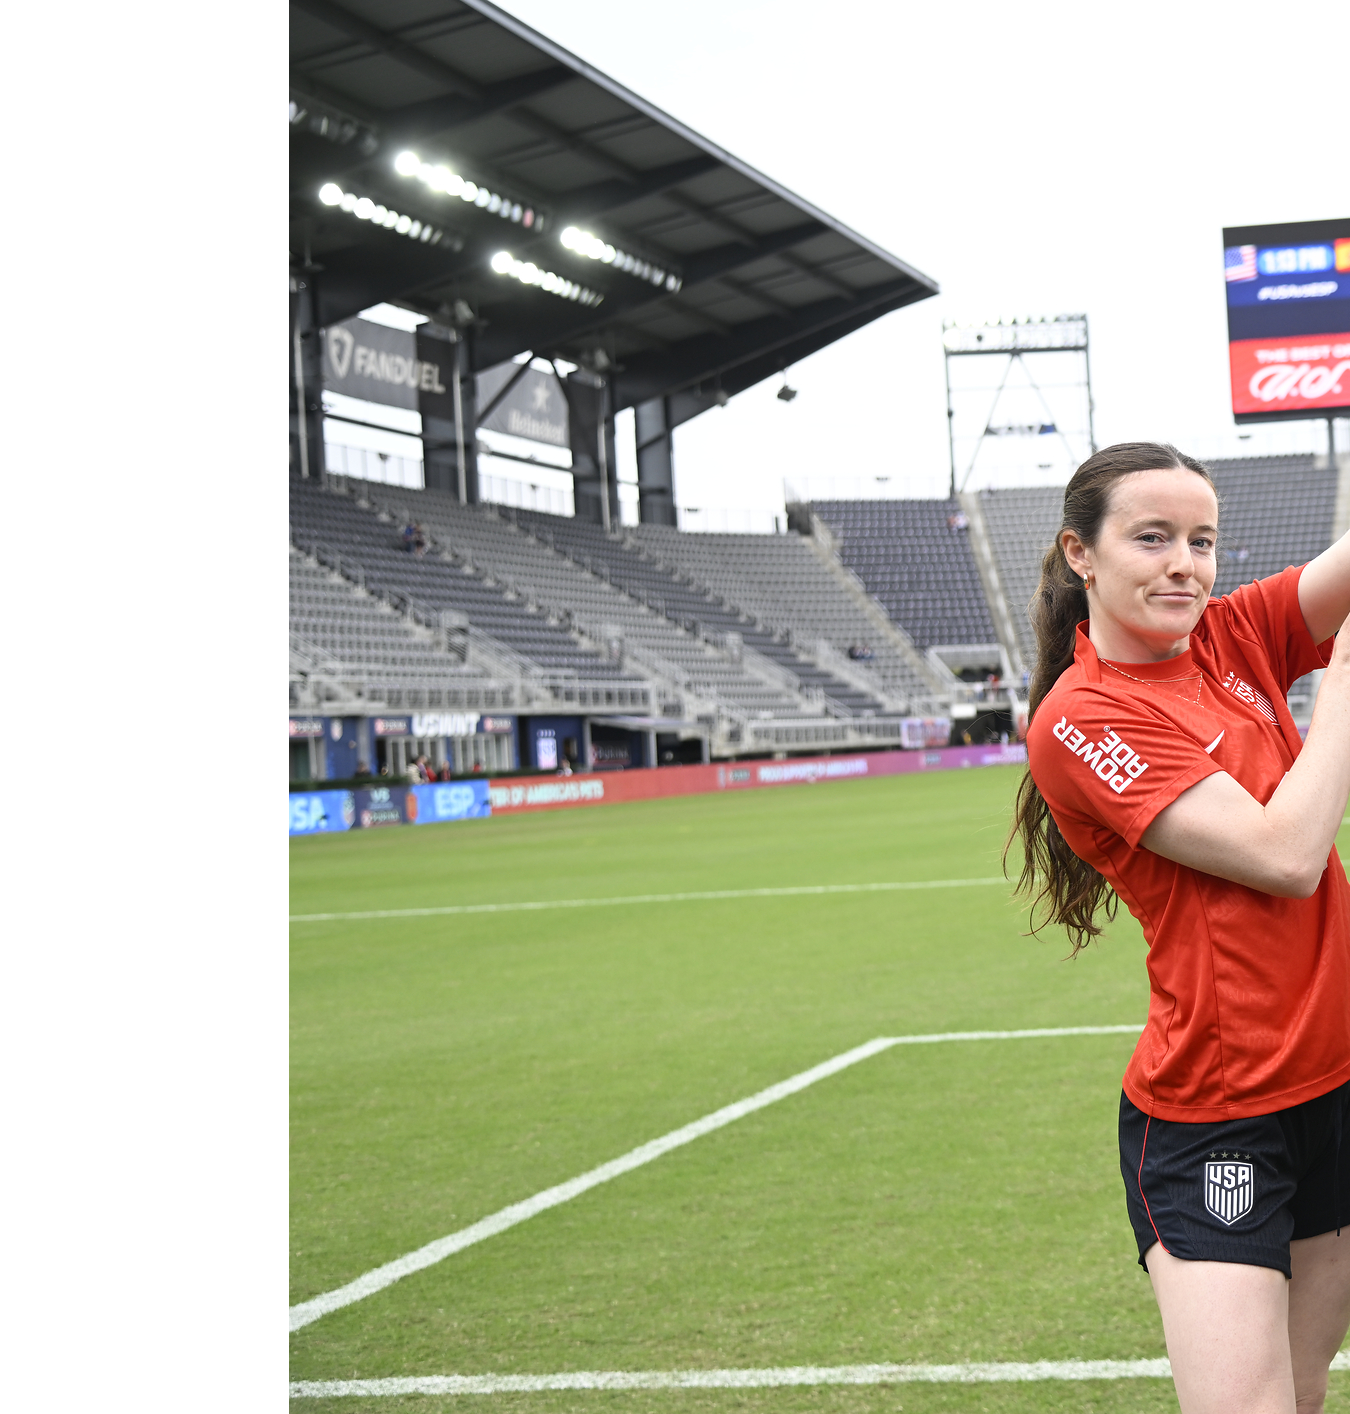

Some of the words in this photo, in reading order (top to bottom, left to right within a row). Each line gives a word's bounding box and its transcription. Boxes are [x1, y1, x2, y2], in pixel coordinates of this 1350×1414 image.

[354, 344, 446, 394] FANDUEL
[1255, 348, 1288, 363] THE
[1289, 345, 1330, 362] BEST
[411, 711, 481, 738] USWNT
[1052, 715, 1134, 795] POWER
[1097, 730, 1150, 780] ADE
[434, 785, 475, 818] ESP
[580, 779, 604, 799] PETS
[1209, 1164, 1250, 1189] USA
